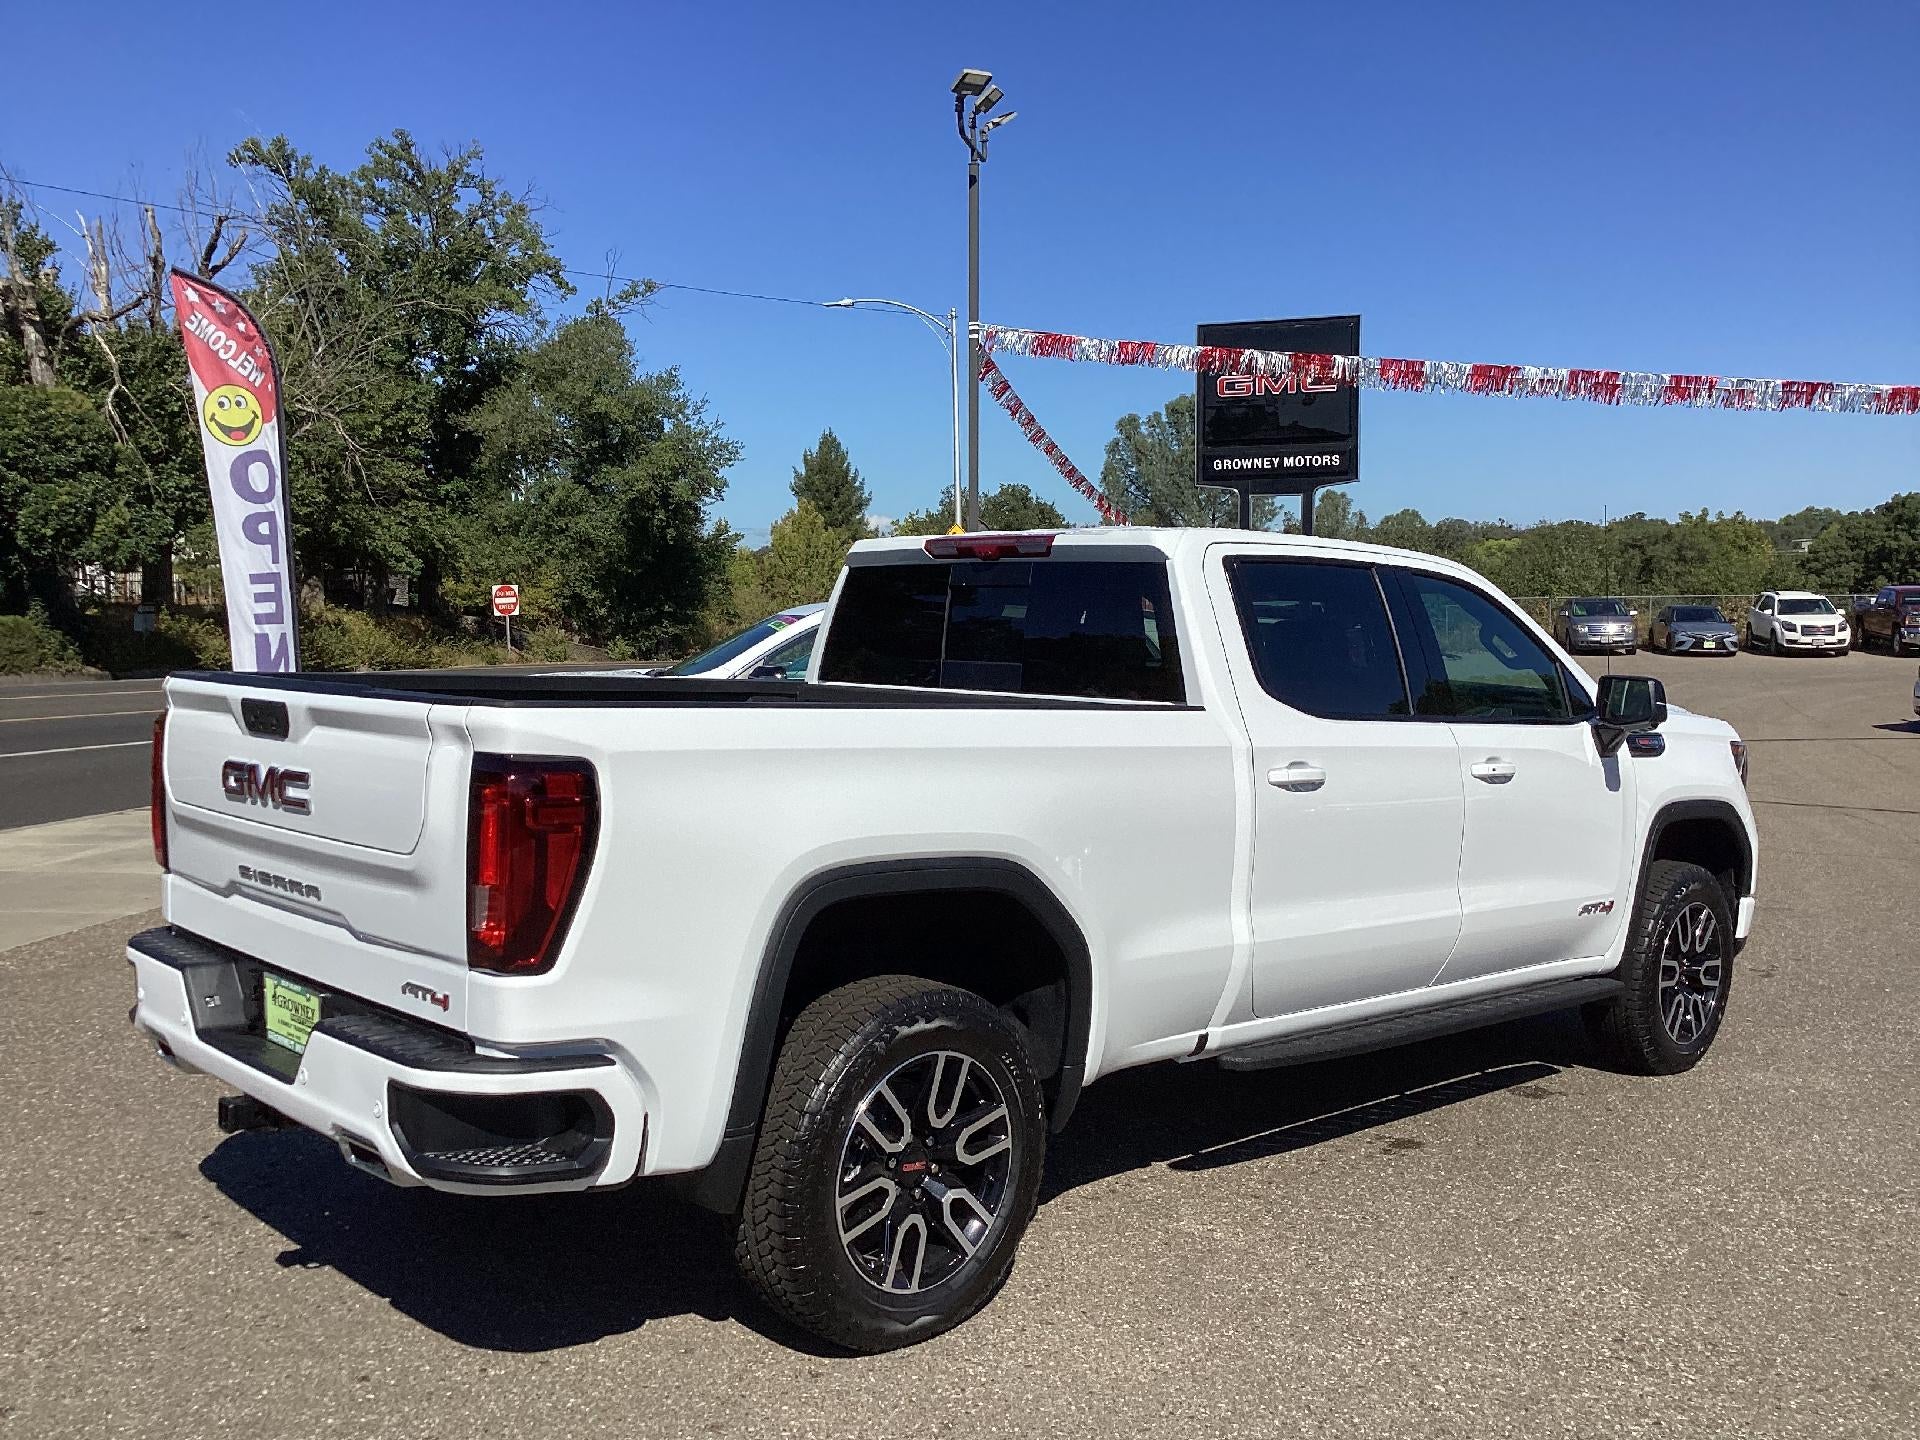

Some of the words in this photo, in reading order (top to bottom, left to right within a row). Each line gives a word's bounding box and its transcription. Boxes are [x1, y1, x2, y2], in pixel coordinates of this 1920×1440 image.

[1213, 457, 1279, 471] GROWNEY
[1283, 455, 1340, 468] MOTORS
[222, 759, 312, 816] GMC
[238, 864, 322, 902] SIERRA
[1578, 899, 1615, 917] AT4
[277, 994, 316, 1020] GROWNEY
[401, 981, 450, 1012] AT4
